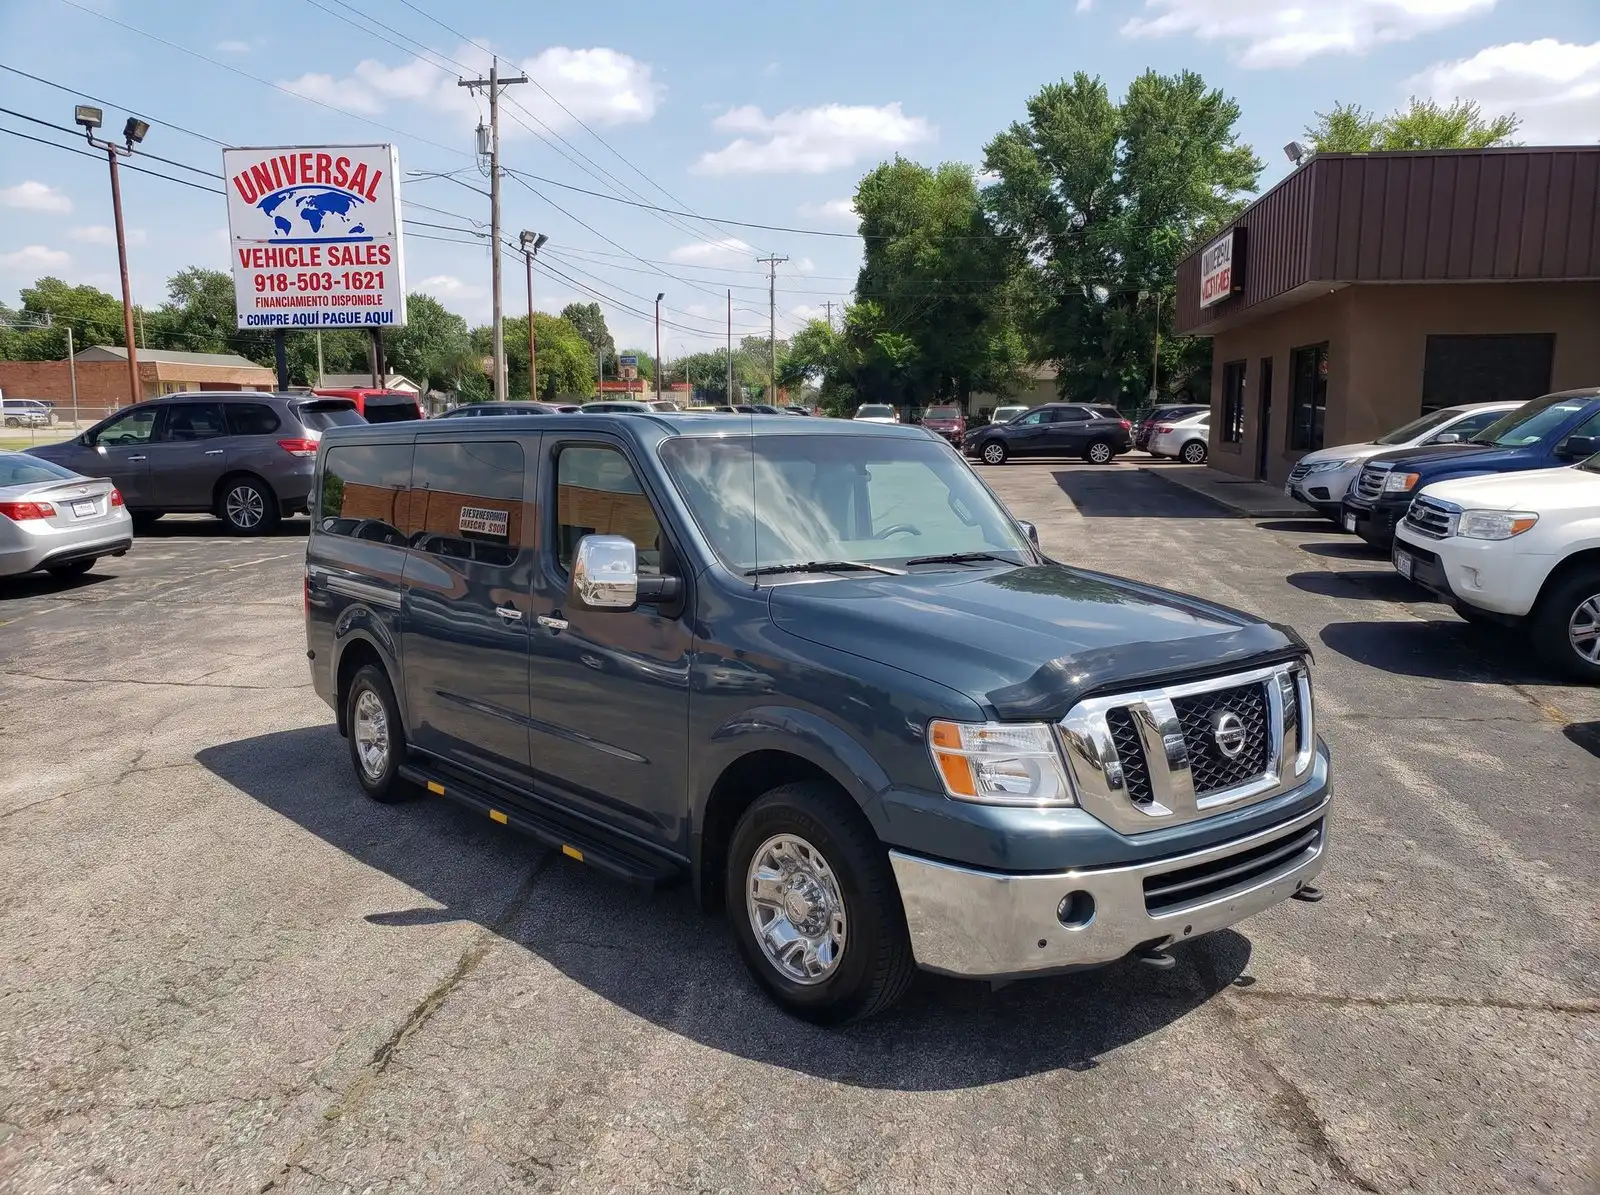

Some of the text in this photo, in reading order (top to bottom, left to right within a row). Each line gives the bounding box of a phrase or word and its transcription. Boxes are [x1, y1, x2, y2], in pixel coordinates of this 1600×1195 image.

[233, 153, 383, 205] UNIVERSAL
[239, 245, 391, 269] VEHICLE SALES
[254, 271, 384, 292] 918-503-1621
[255, 294, 383, 308] FINANCIAMIENTO DISPONIBLE
[247, 309, 393, 326] COMPRE AQUÍ PAGUE AQUÍ
